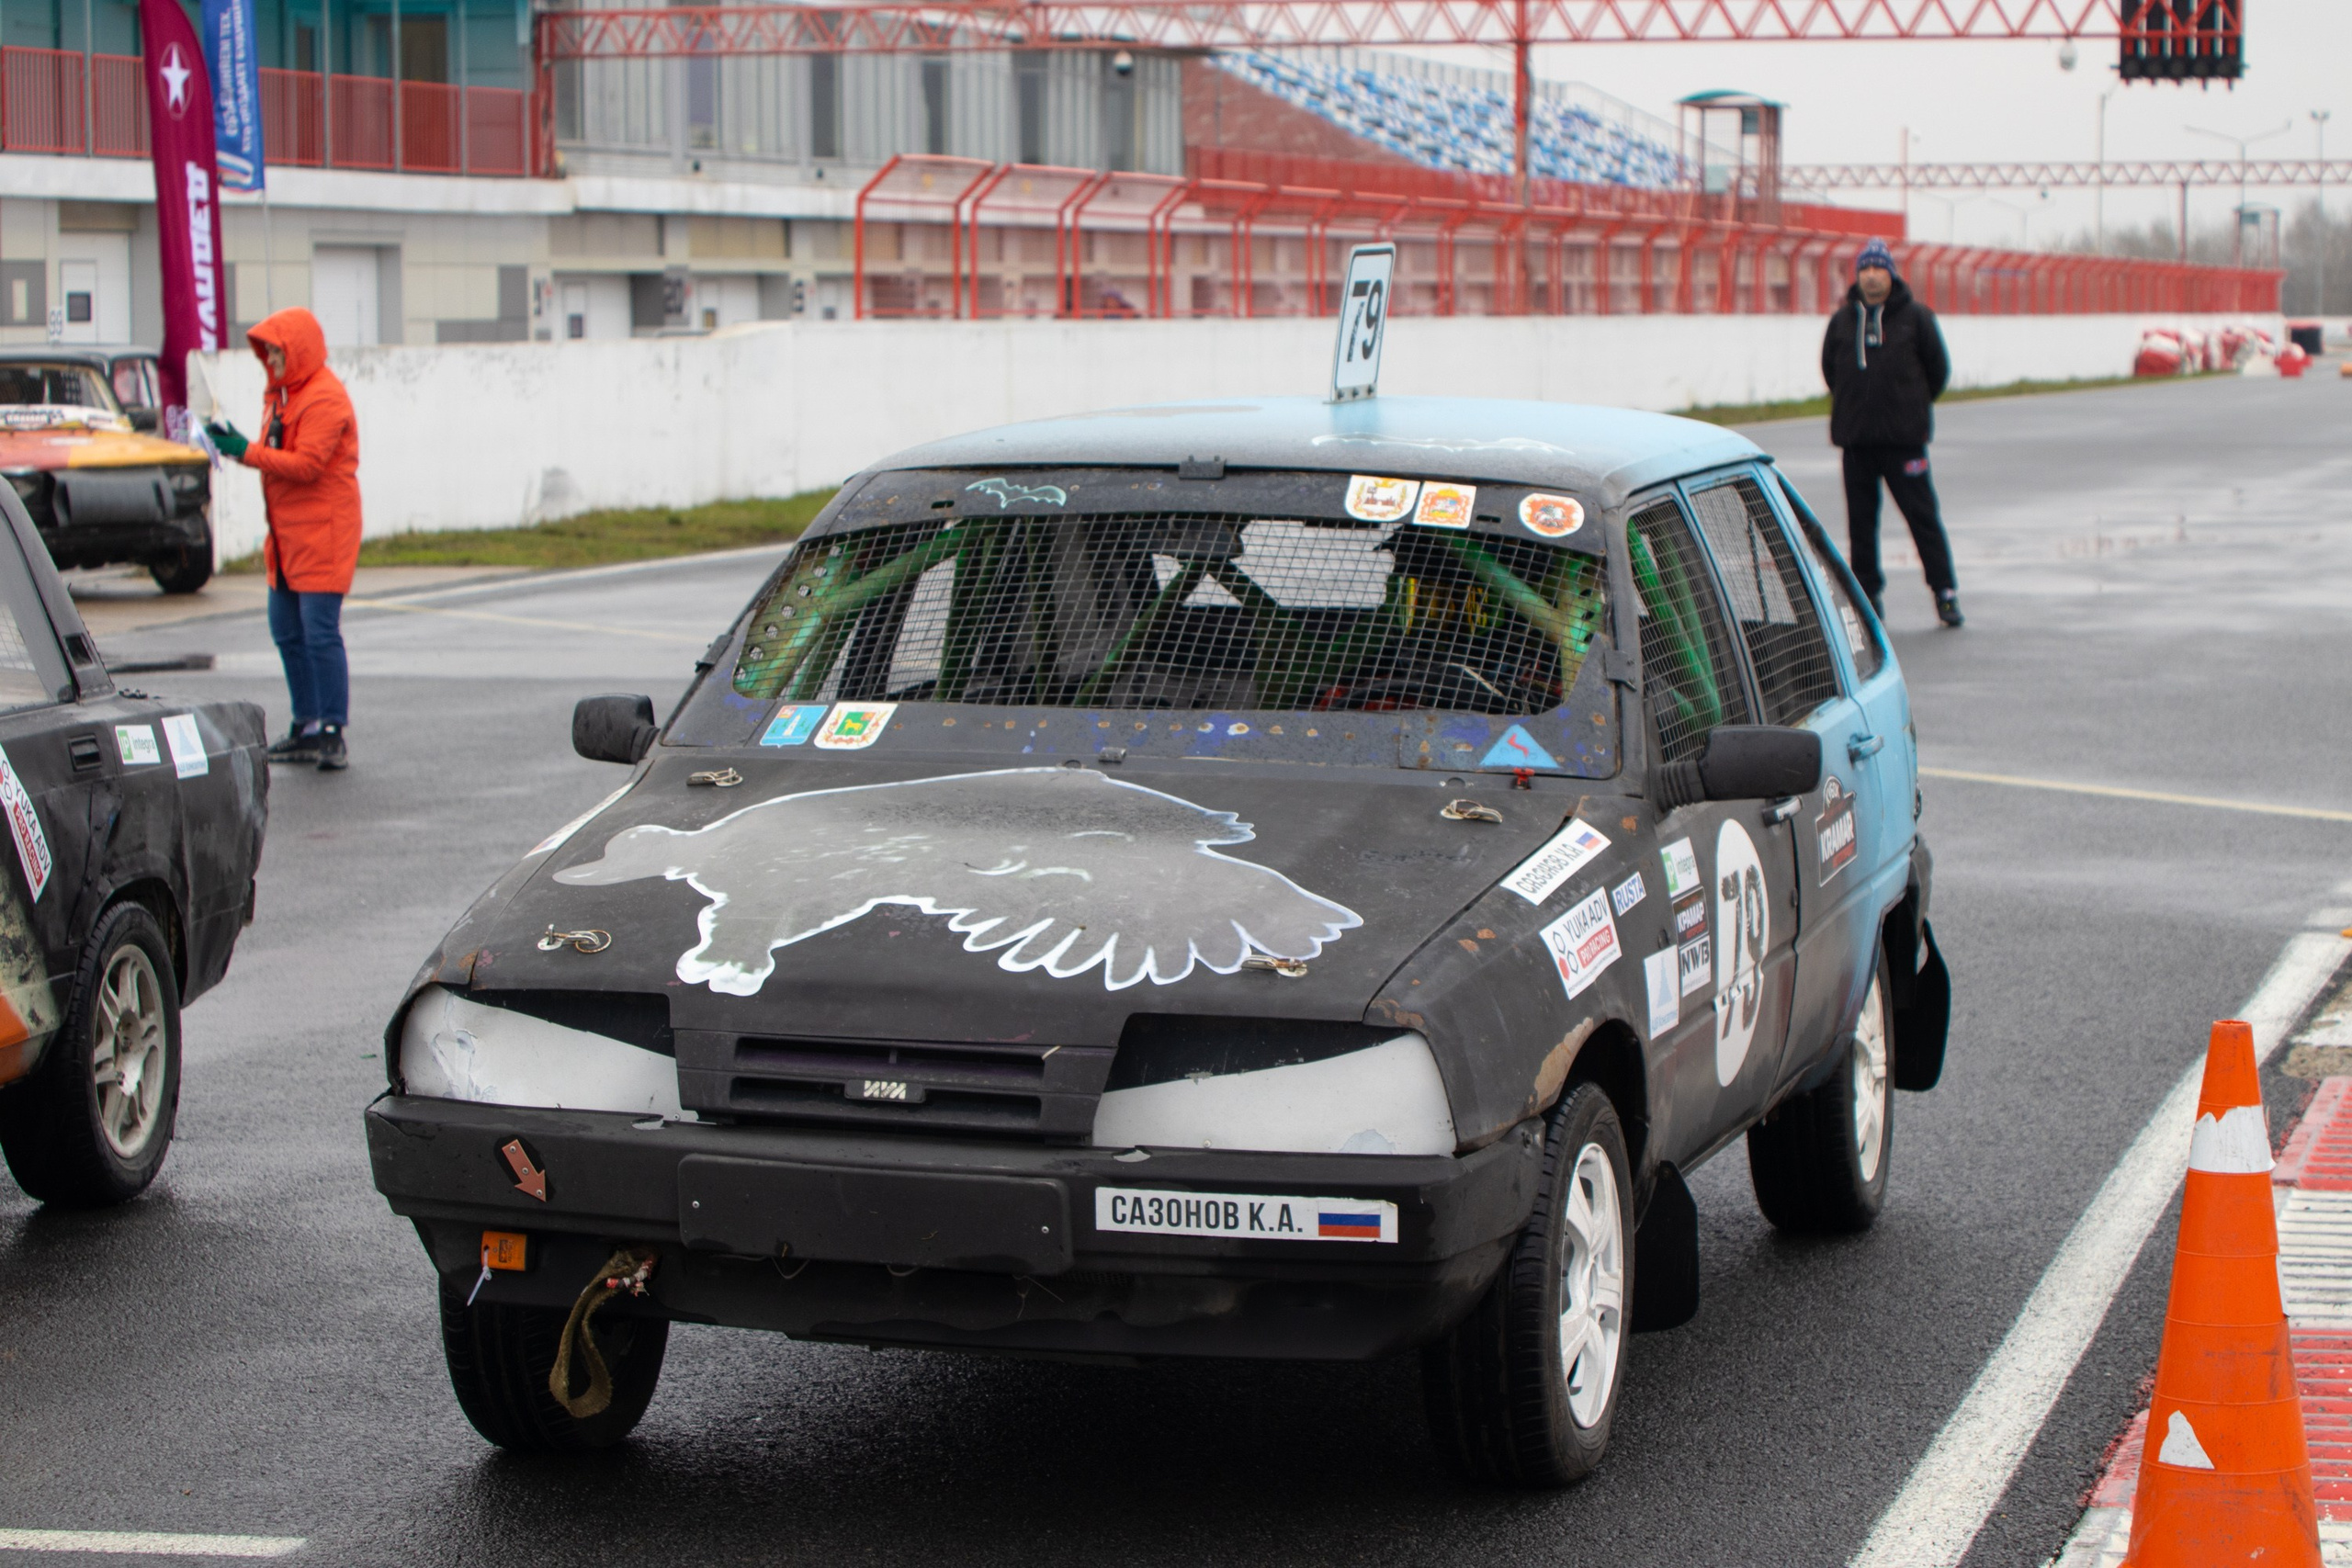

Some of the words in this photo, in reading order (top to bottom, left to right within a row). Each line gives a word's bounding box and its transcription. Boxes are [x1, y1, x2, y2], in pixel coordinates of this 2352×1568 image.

[1347, 278, 1384, 363] 79
[132, 736, 156, 754] integra
[15, 780, 37, 836] YUKA
[35, 835, 51, 871] ADV
[15, 807, 27, 834] PRO
[24, 833, 40, 881] RACING
[1820, 810, 1855, 863] KRAMAR
[1676, 854, 1696, 875] integra
[1615, 875, 1645, 913] RUSTA
[1563, 909, 1590, 942] YUKA
[1588, 895, 1608, 929] ADV
[1590, 928, 1611, 956] RACING
[1681, 940, 1710, 976] NWB
[1721, 864, 1765, 1040] 79
[1111, 1195, 1239, 1230] САЗОНОВ
[1249, 1202, 1303, 1233] К.А.
